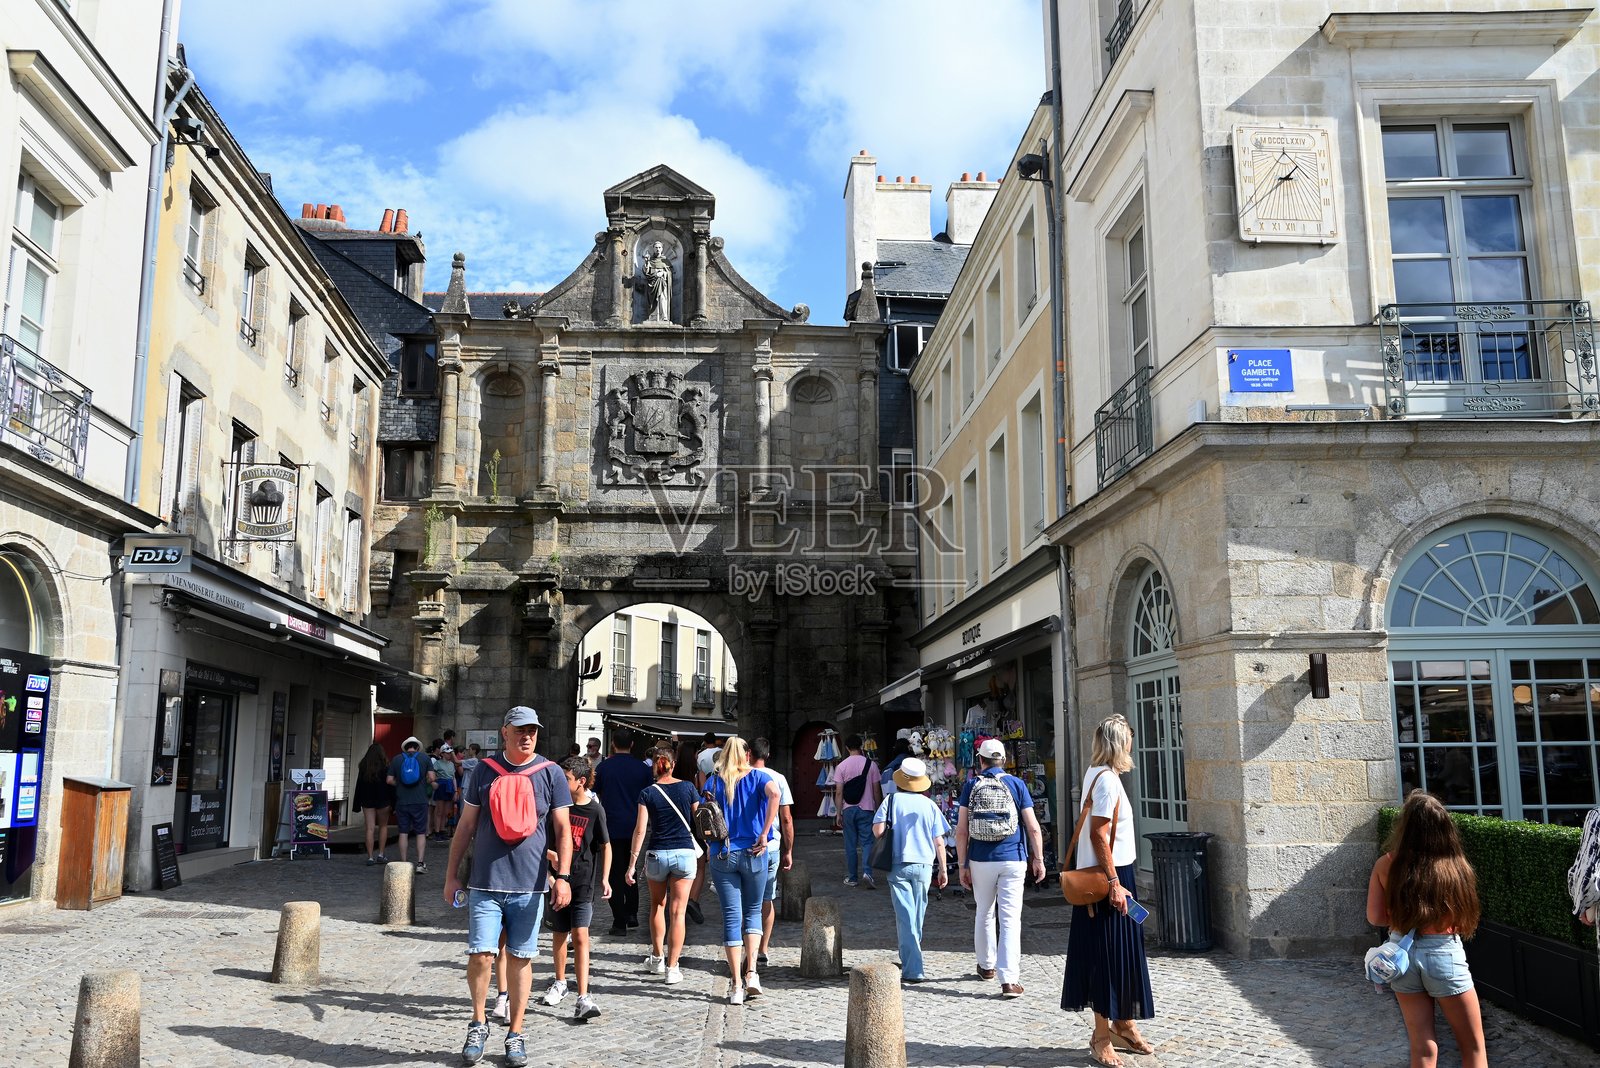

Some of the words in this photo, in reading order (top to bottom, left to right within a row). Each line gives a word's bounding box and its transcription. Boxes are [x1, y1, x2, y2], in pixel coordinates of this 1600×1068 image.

[1285, 222, 1295, 231] XII
[1248, 359, 1272, 367] PLACE
[1241, 368, 1280, 376] GAMBETTA
[134, 549, 164, 562] FDJ
[171, 574, 214, 599] VIENNOISERIE
[215, 592, 245, 611] PATISSERIE
[28, 677, 40, 689] FDJ
[297, 814, 323, 822] Snacking
